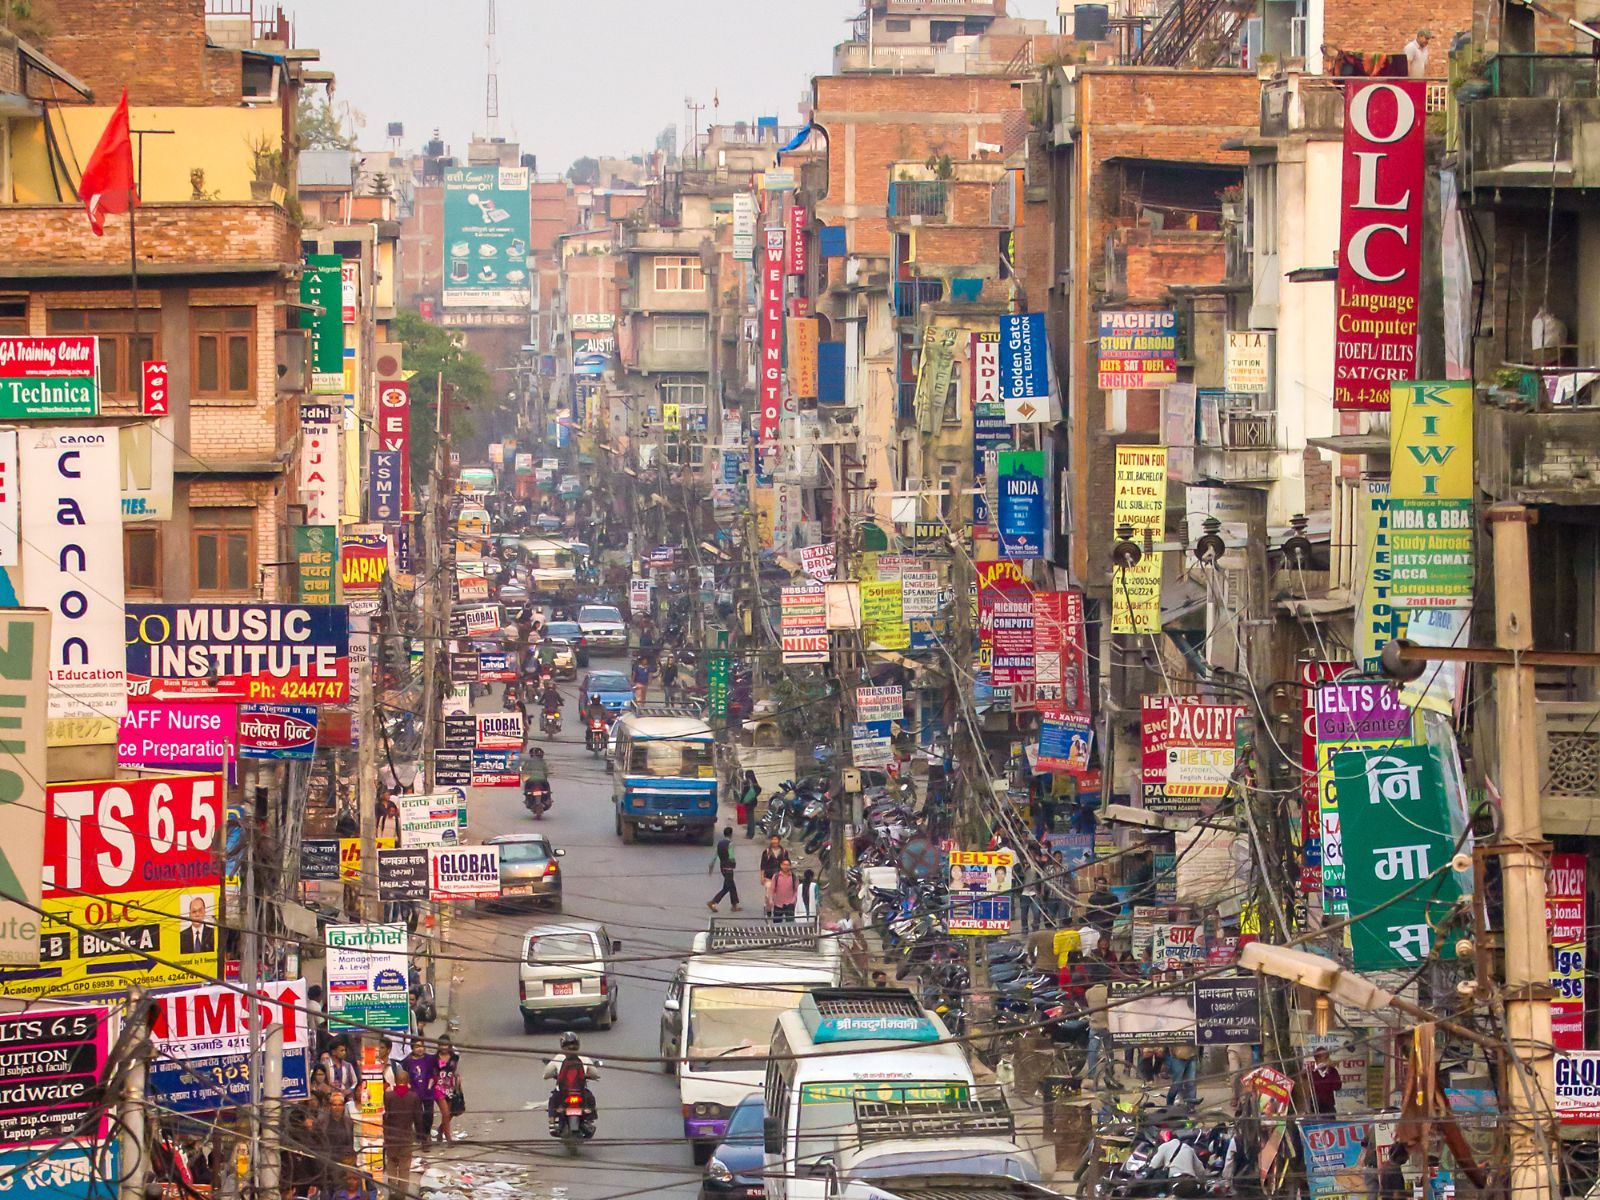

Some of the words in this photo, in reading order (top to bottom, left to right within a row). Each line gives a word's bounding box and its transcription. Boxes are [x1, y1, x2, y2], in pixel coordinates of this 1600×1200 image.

[1347, 83, 1415, 282] OLC
[1340, 288, 1414, 315] Language
[1101, 313, 1174, 328] PACIFIC
[1339, 314, 1416, 337] Computer
[1010, 317, 1020, 349] Gate
[765, 250, 783, 438] WELLINGTON
[1022, 316, 1032, 371] EDUCATION
[1101, 337, 1132, 350] STUDY
[1134, 336, 1174, 350] ABROAD
[17, 341, 56, 368] Training
[58, 341, 90, 361] Center
[981, 343, 995, 402] INDIA
[1101, 360, 1120, 371] IELTS
[1124, 360, 1139, 371] SAT
[1012, 352, 1023, 397] Golden
[1101, 373, 1143, 388] ENGLISH
[1338, 366, 1409, 381] SAT/GRE
[9, 382, 90, 404] Technica
[1335, 387, 1353, 403] Ph.
[59, 434, 104, 444] canon
[1406, 386, 1457, 496] KIWI
[1118, 453, 1150, 466] TUITION
[1152, 453, 1165, 466] FOR
[376, 455, 392, 504] KSMT
[1007, 481, 1039, 495] INDIA
[1117, 500, 1128, 510] ALL
[1117, 515, 1160, 524] LANGUAGE
[1392, 510, 1424, 529] MBA
[1427, 513, 1438, 529] &
[1440, 510, 1469, 528] BBA
[1393, 535, 1426, 551] Study
[1429, 535, 1469, 550] Abroad
[57, 451, 89, 665] canon
[1393, 554, 1469, 566] IELTS/GMAT
[343, 557, 387, 583] JAPAN
[1392, 568, 1428, 579] ACCA
[781, 586, 825, 595] MBBS/BDS
[904, 581, 936, 589] ENGLISH
[1392, 584, 1469, 596] Languages
[904, 589, 937, 597] SPEAKING
[1406, 596, 1427, 606] 2nd
[1429, 596, 1457, 606] Floor
[176, 609, 312, 642] MUSIC
[1067, 595, 1077, 644] Japan
[783, 628, 803, 637] Bridge
[784, 637, 829, 651] NIMS
[151, 646, 337, 677] INSTITUTE
[57, 668, 124, 682] Education
[250, 682, 276, 698] Ph:
[281, 681, 344, 698] 4244747
[1319, 685, 1373, 714] IELTS
[168, 710, 221, 730] Nurse
[483, 718, 521, 731] GLOBAL
[1058, 713, 1090, 724] XAVIER
[142, 739, 235, 761] Preparation
[1180, 748, 1233, 765] IELTS
[473, 760, 504, 771] Latvia
[473, 774, 501, 784] raffles
[1167, 785, 1200, 795] STUDY
[149, 780, 216, 855] 6.5
[440, 854, 498, 873] GLOBAL
[951, 853, 1012, 865] IELTS
[440, 874, 499, 882] EDUCATION
[84, 900, 141, 926] OLC
[950, 919, 985, 929] PACIFIC
[3, 984, 47, 996] Academy
[344, 993, 378, 1001] NIMAS
[50, 1016, 88, 1036] 6.5
[7, 1064, 34, 1077] subject
[4, 1128, 37, 1140] Laptop
